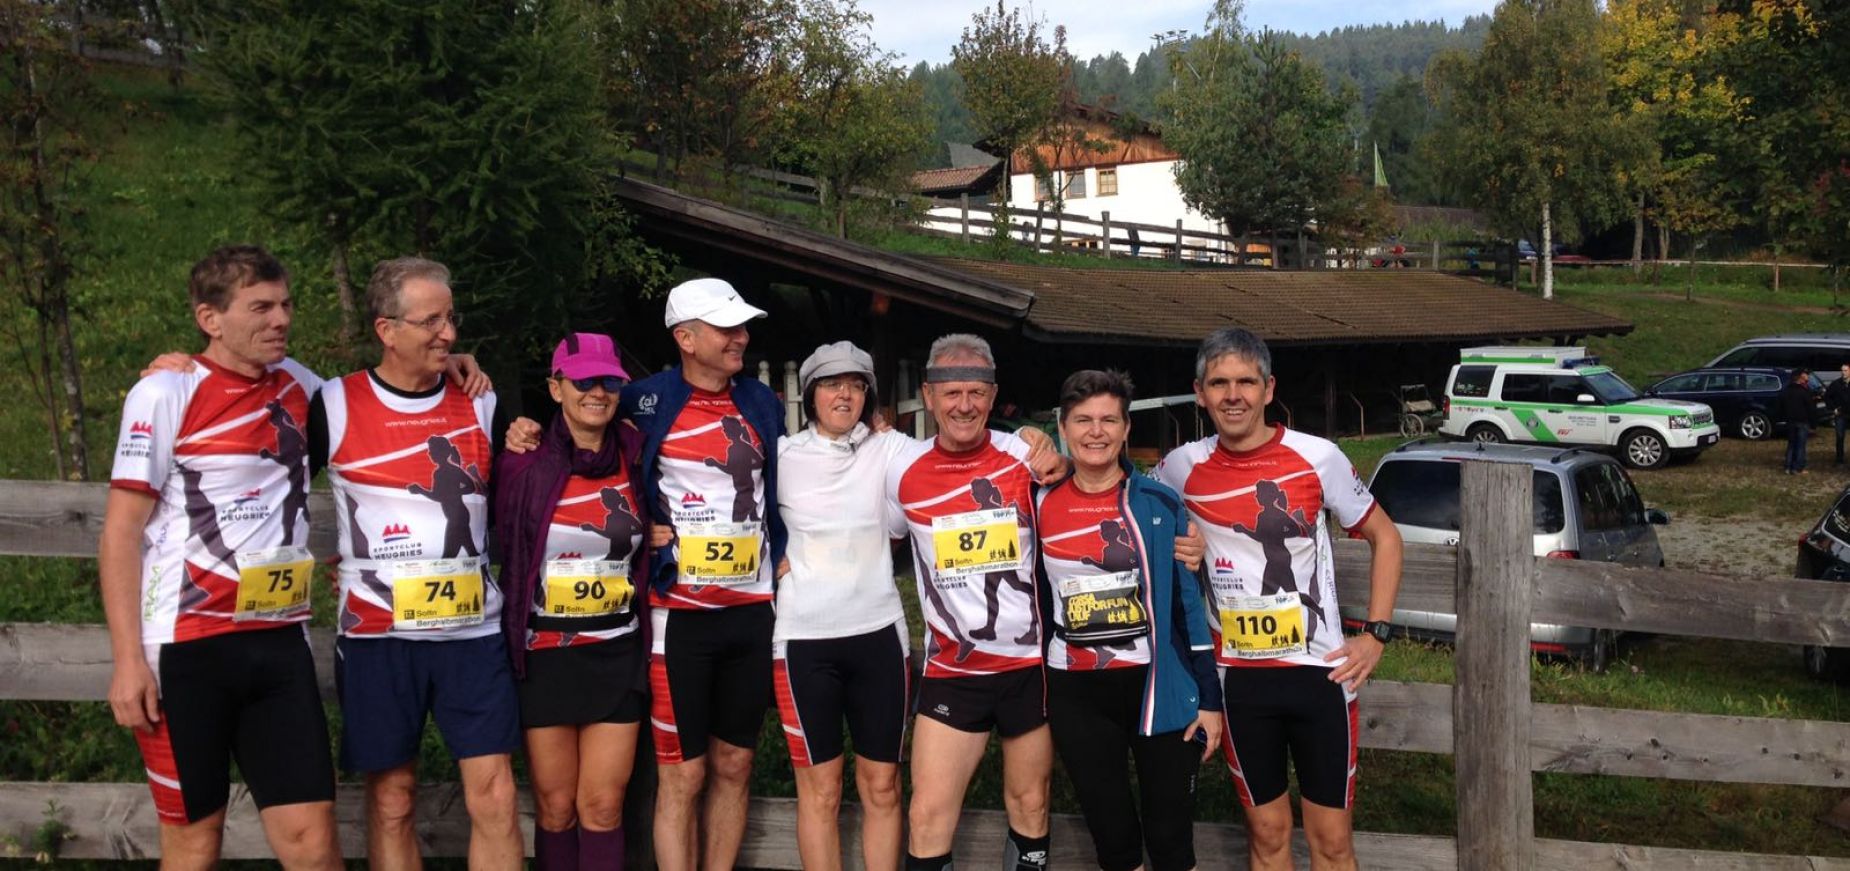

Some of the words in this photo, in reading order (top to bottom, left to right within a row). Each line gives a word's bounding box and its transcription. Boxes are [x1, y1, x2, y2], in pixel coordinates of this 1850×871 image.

[705, 541, 734, 562] 52
[959, 530, 987, 552] 87
[374, 549, 423, 560] NEUGRIES
[268, 568, 293, 593] 75
[574, 580, 606, 600] 90
[425, 580, 456, 603] 74
[1236, 615, 1277, 635] 110
